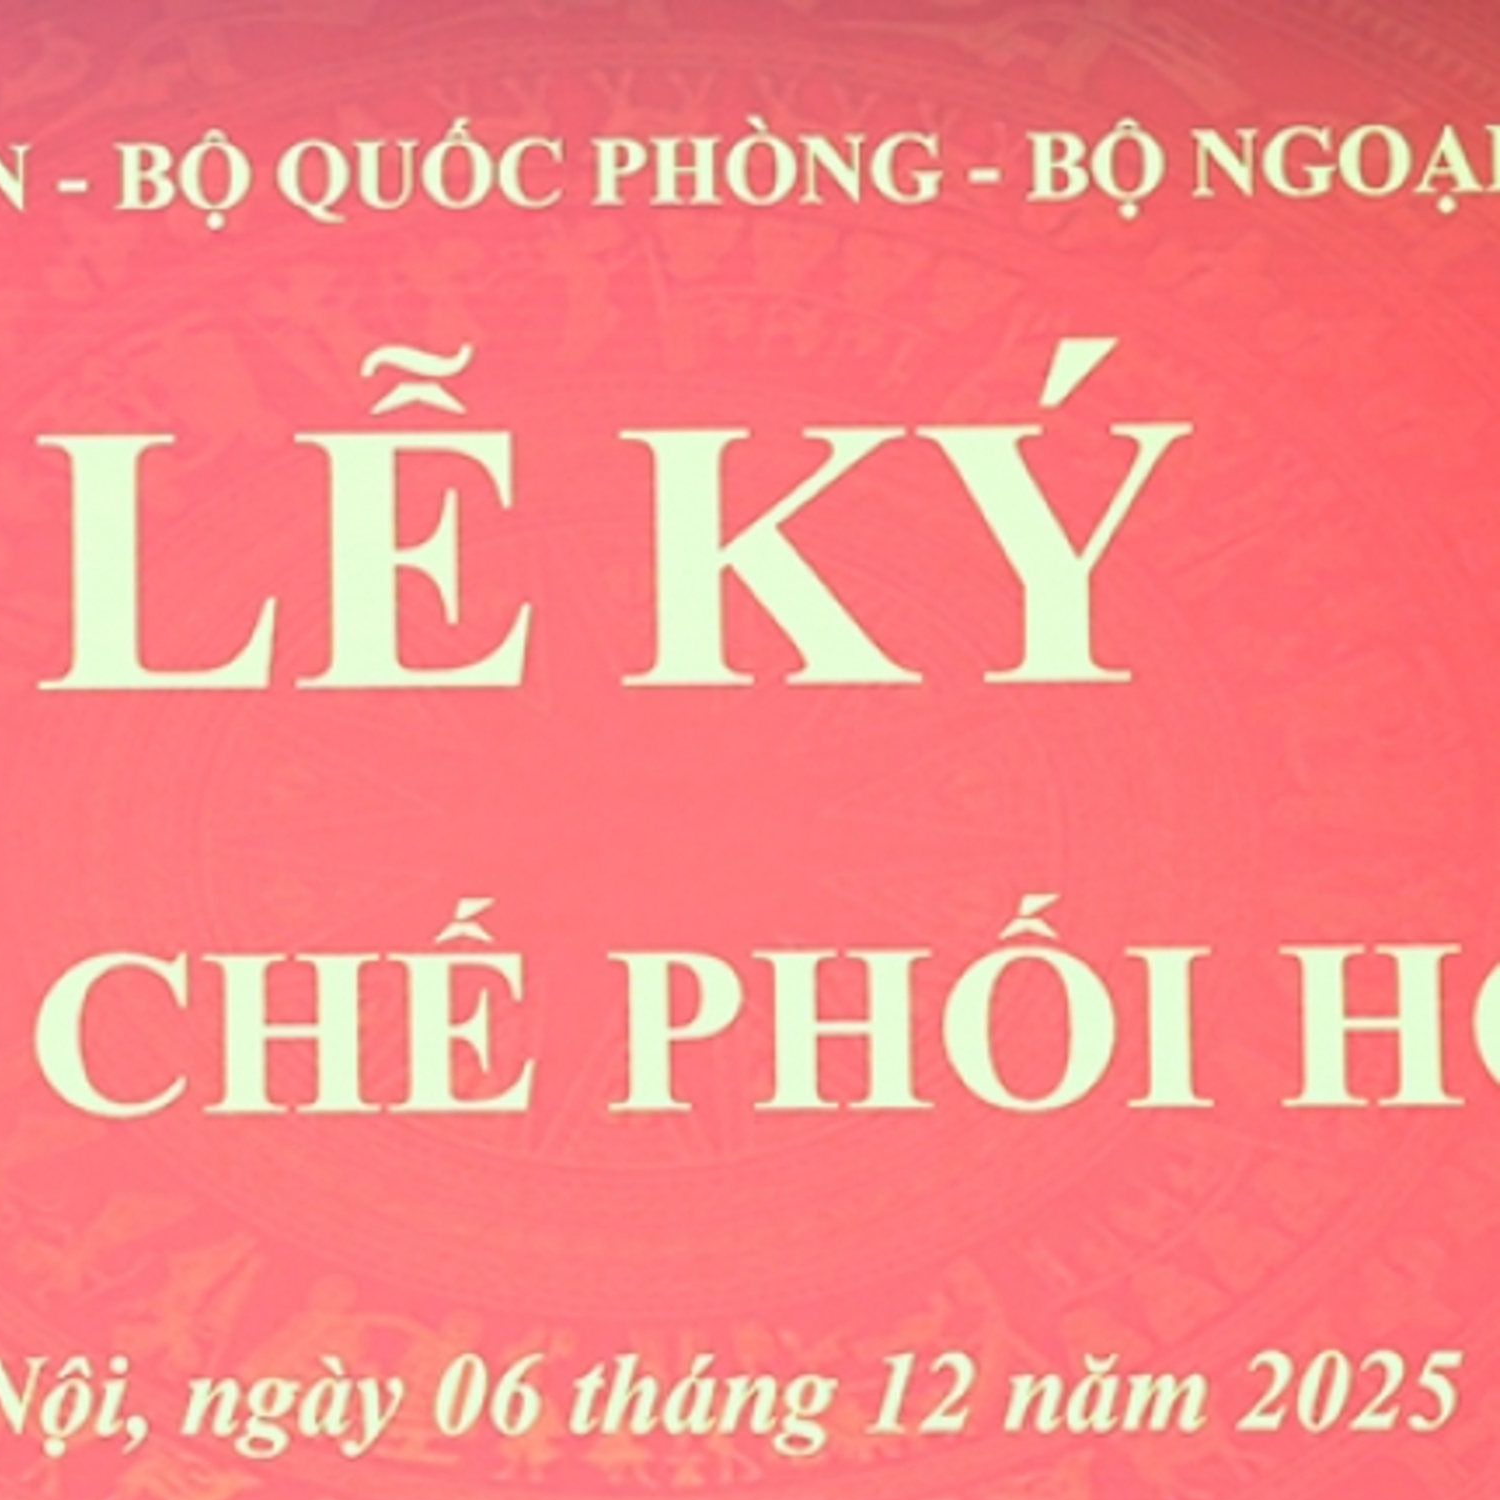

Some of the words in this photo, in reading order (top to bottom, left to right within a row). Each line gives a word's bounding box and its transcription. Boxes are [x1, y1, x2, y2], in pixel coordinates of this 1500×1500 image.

[57, 178, 89, 193] -
[116, 136, 252, 231] BỘ
[276, 117, 563, 224] QUỐC
[592, 115, 943, 206] PHÒNG
[968, 167, 1001, 183] -
[1028, 117, 1165, 220] BỘ
[36, 341, 532, 692] LỄ
[618, 336, 1194, 687] KÝ
[33, 892, 536, 1119] CHẾ
[606, 892, 1215, 1113] PHỐI
[1279, 943, 1500, 1108] H
[180, 1354, 406, 1460] ngày
[432, 1352, 545, 1438] 06
[568, 1352, 839, 1458] tháng
[867, 1350, 976, 1435] 12
[1003, 1352, 1208, 1435] năm
[1236, 1348, 1464, 1433] 2025
